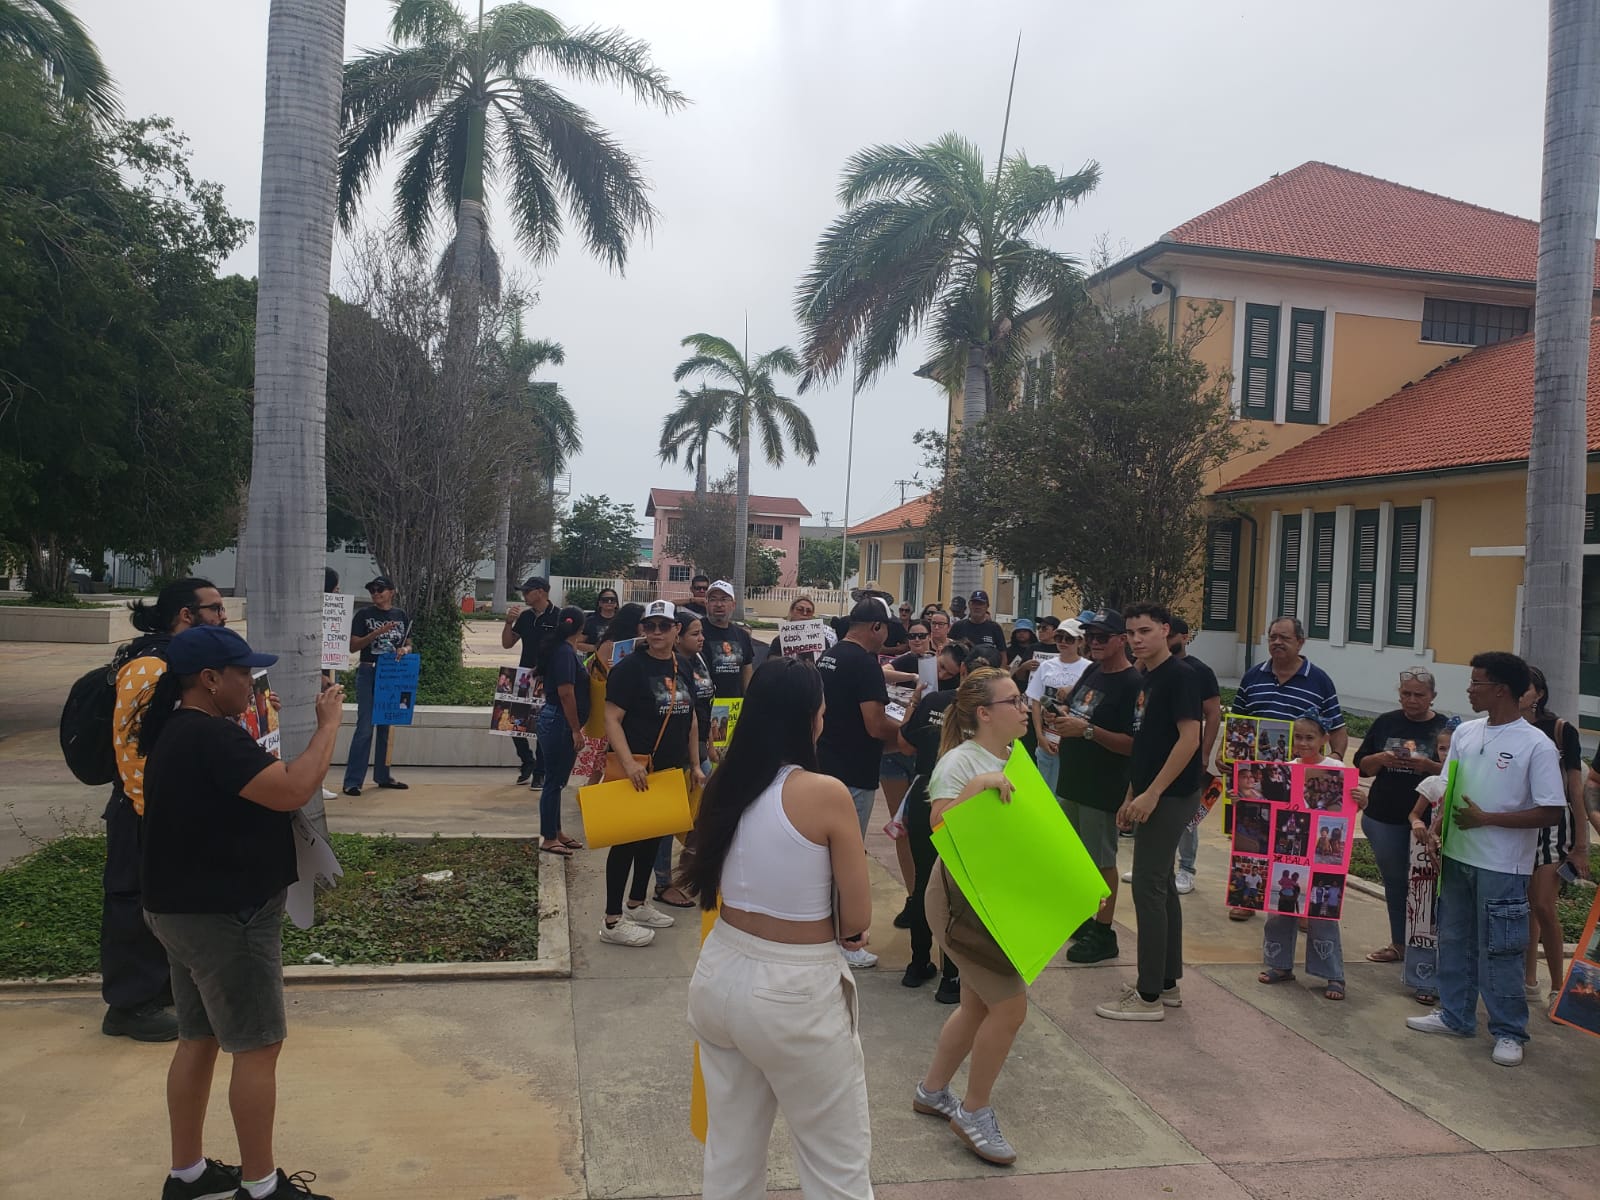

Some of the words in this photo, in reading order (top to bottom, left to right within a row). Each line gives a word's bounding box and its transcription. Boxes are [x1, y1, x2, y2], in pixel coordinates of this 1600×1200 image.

[781, 624, 805, 632] ARREST
[784, 634, 801, 642] COPS
[783, 643, 823, 654] MURDERED
[1285, 855, 1311, 867] BALA
